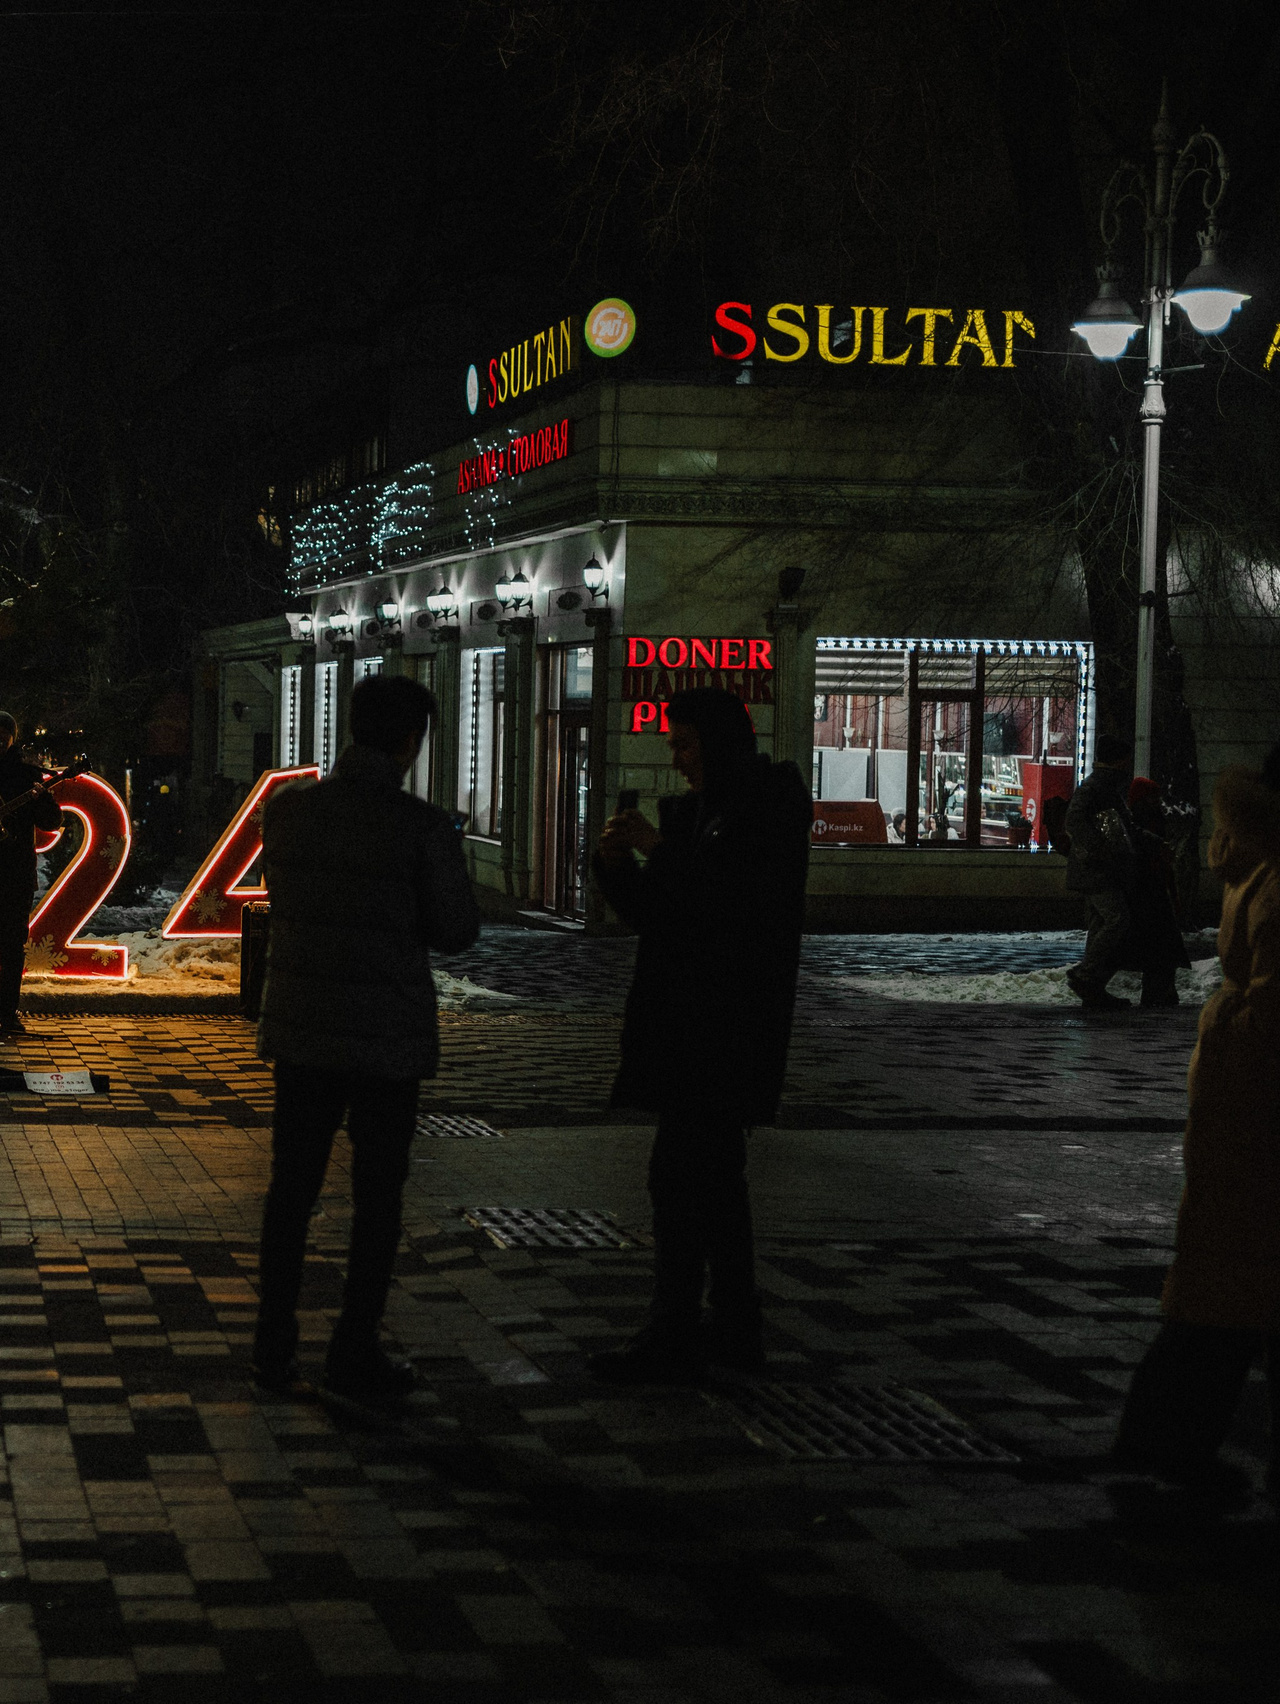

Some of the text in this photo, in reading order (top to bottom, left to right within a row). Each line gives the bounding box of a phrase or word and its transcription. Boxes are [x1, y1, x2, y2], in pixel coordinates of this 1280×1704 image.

[488, 316, 571, 409] SSULTAN
[507, 418, 569, 477] СТОЛОВАЯ
[627, 637, 773, 670] DONER
[828, 823, 864, 833] Kaspi.kz
